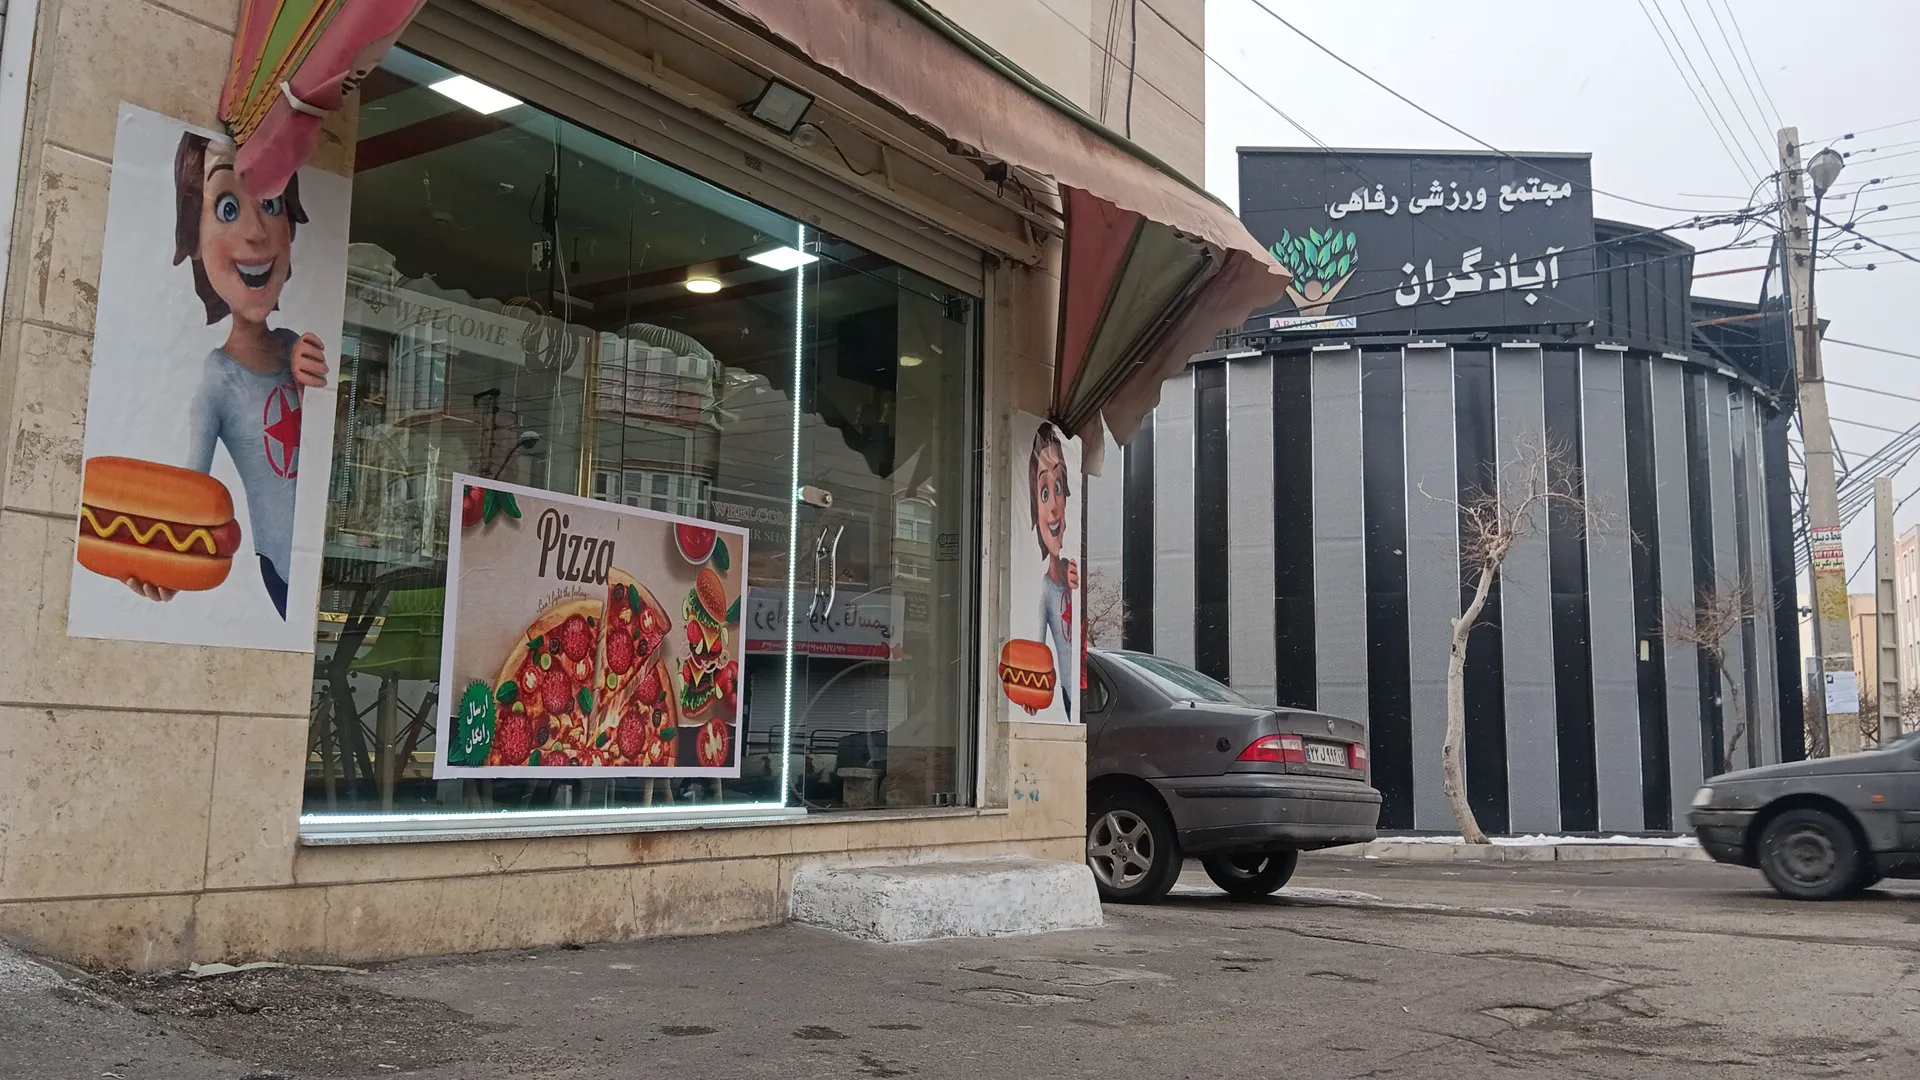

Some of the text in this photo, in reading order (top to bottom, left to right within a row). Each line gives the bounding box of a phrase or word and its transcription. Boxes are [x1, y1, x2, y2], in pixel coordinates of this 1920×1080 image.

[1328, 177, 1573, 219] مجتمع ورزشی رفاهی
[1395, 245, 1565, 307] آبادگران
[395, 298, 509, 347] WELCOME
[536, 507, 616, 586] Pizza
[466, 693, 489, 725] ارسال
[465, 723, 491, 754] رایگان
